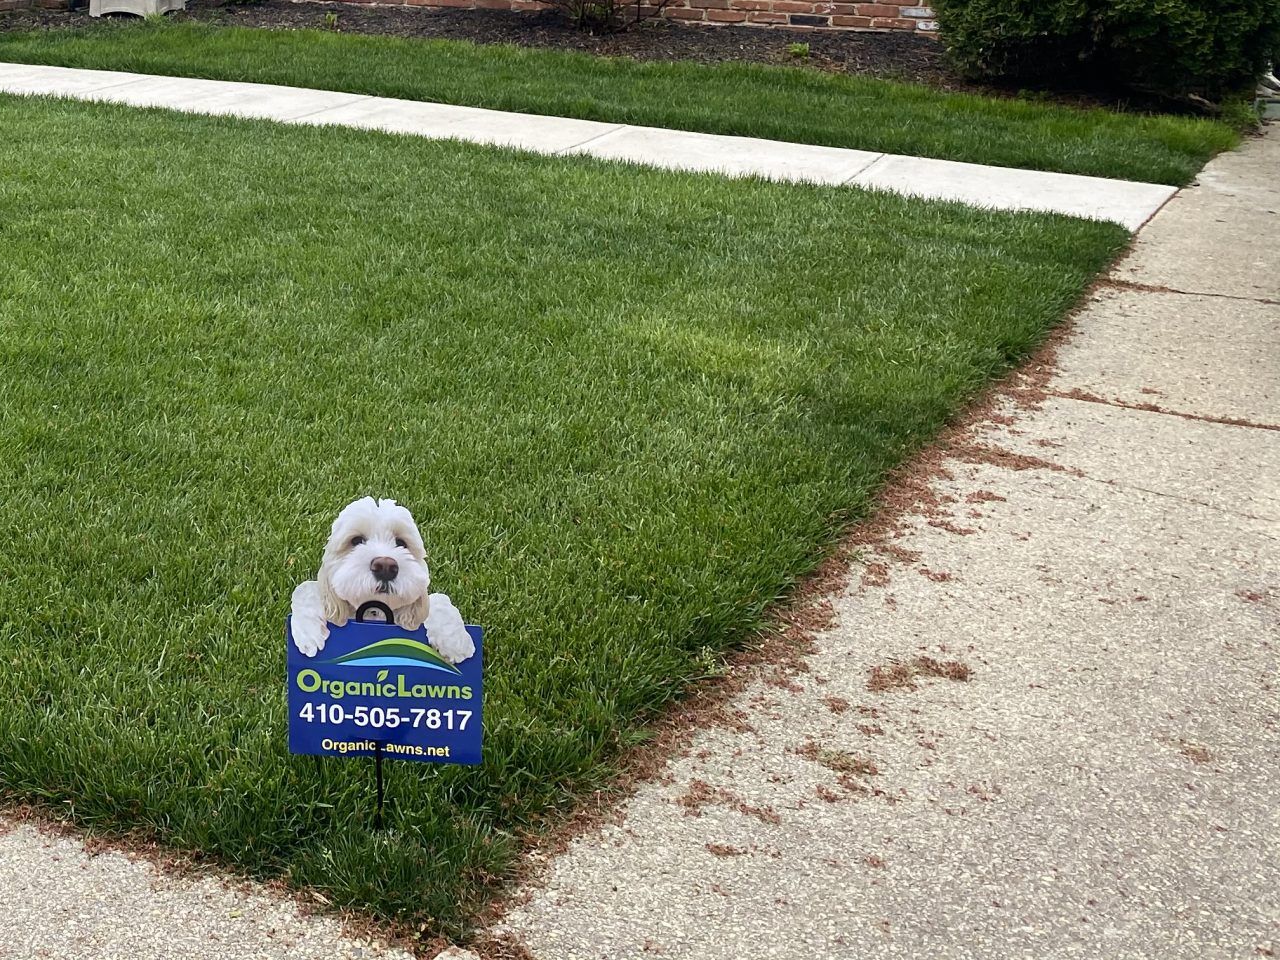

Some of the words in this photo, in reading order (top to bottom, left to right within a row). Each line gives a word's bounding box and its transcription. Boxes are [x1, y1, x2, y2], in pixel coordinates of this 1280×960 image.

[296, 669, 473, 700] OrganicLawns
[299, 702, 473, 731] 410-505-7817
[321, 738, 451, 758] Organicawns.net
